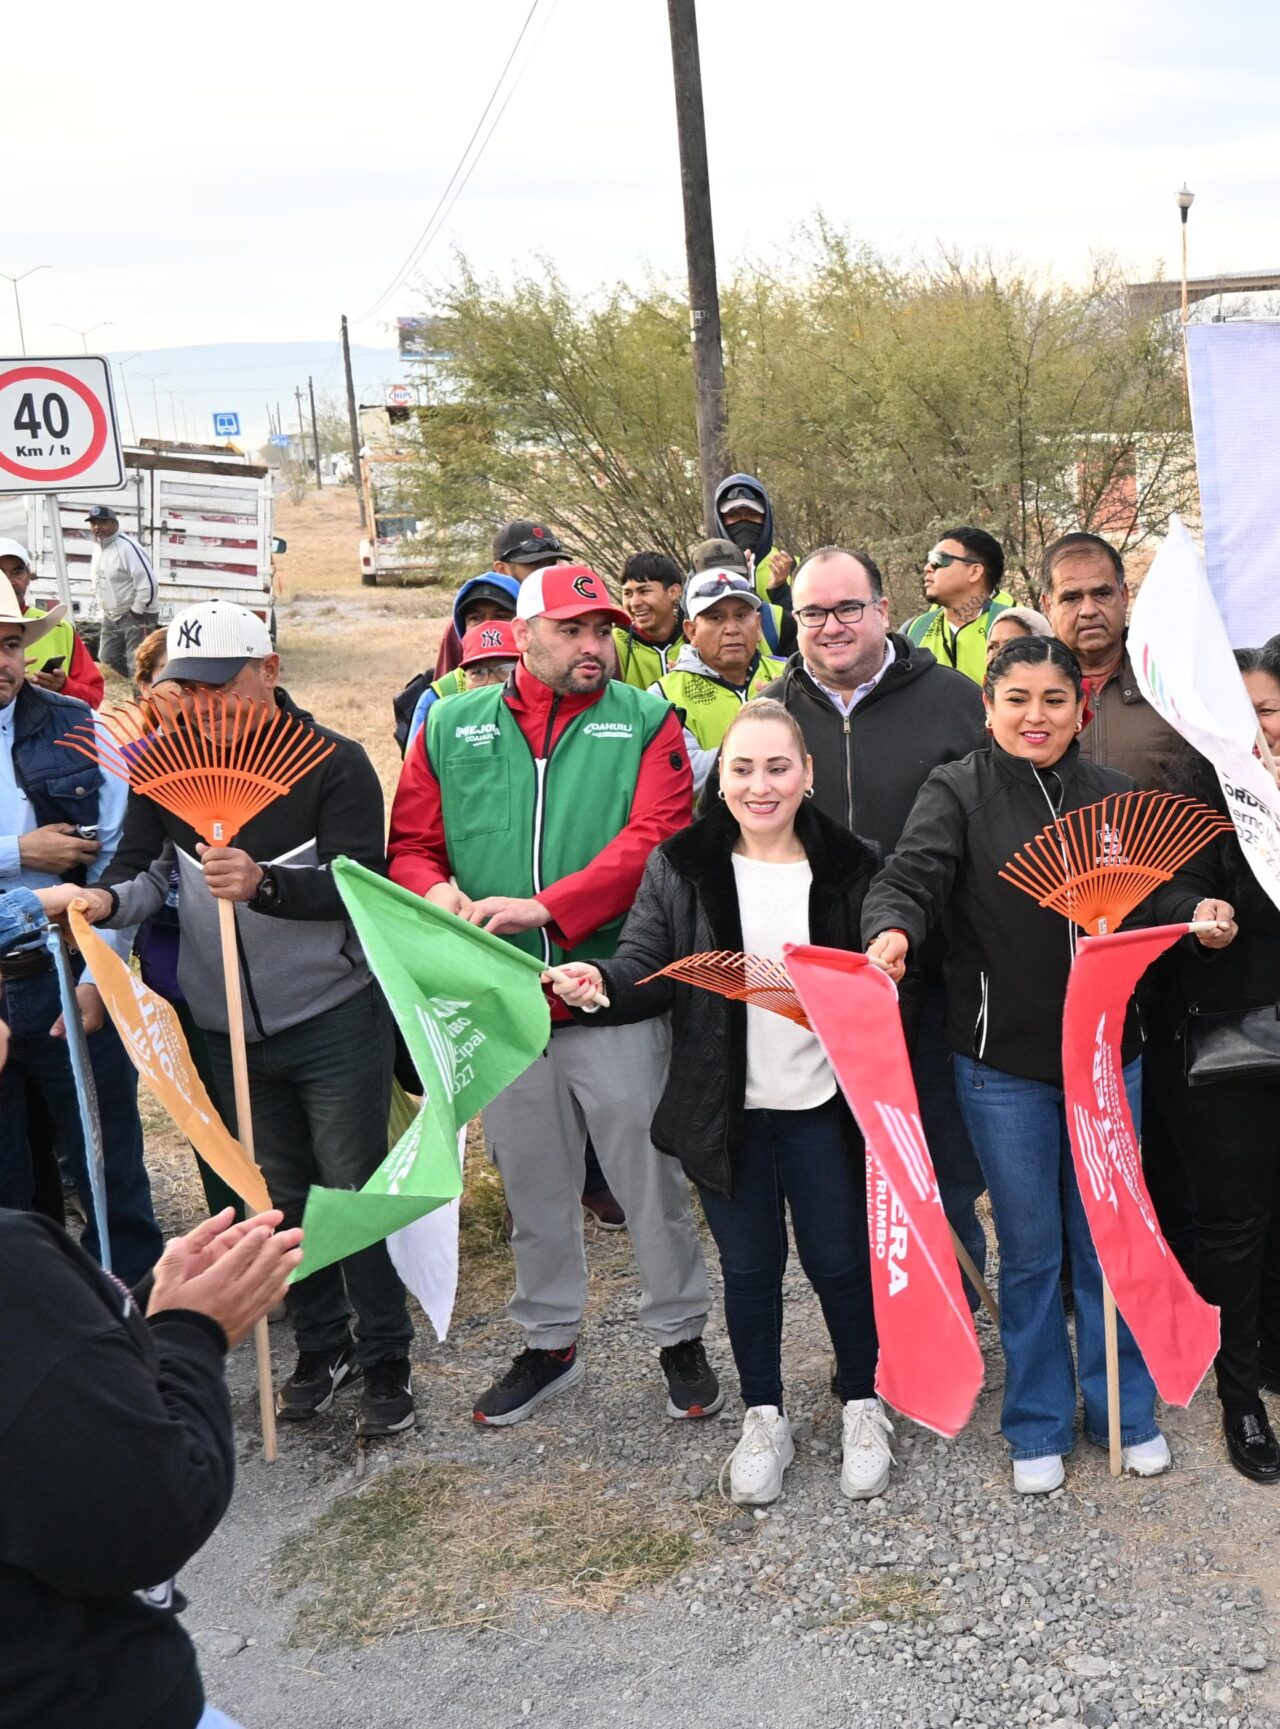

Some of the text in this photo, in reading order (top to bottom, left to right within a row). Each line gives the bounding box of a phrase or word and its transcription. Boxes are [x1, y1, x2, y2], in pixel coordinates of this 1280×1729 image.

[14, 392, 70, 439] 40
[16, 445, 43, 457] Km
[60, 444, 71, 455] h
[573, 575, 598, 599] C
[177, 619, 203, 649] NY
[455, 1028, 488, 1064] cipal
[453, 1063, 477, 1095] 027
